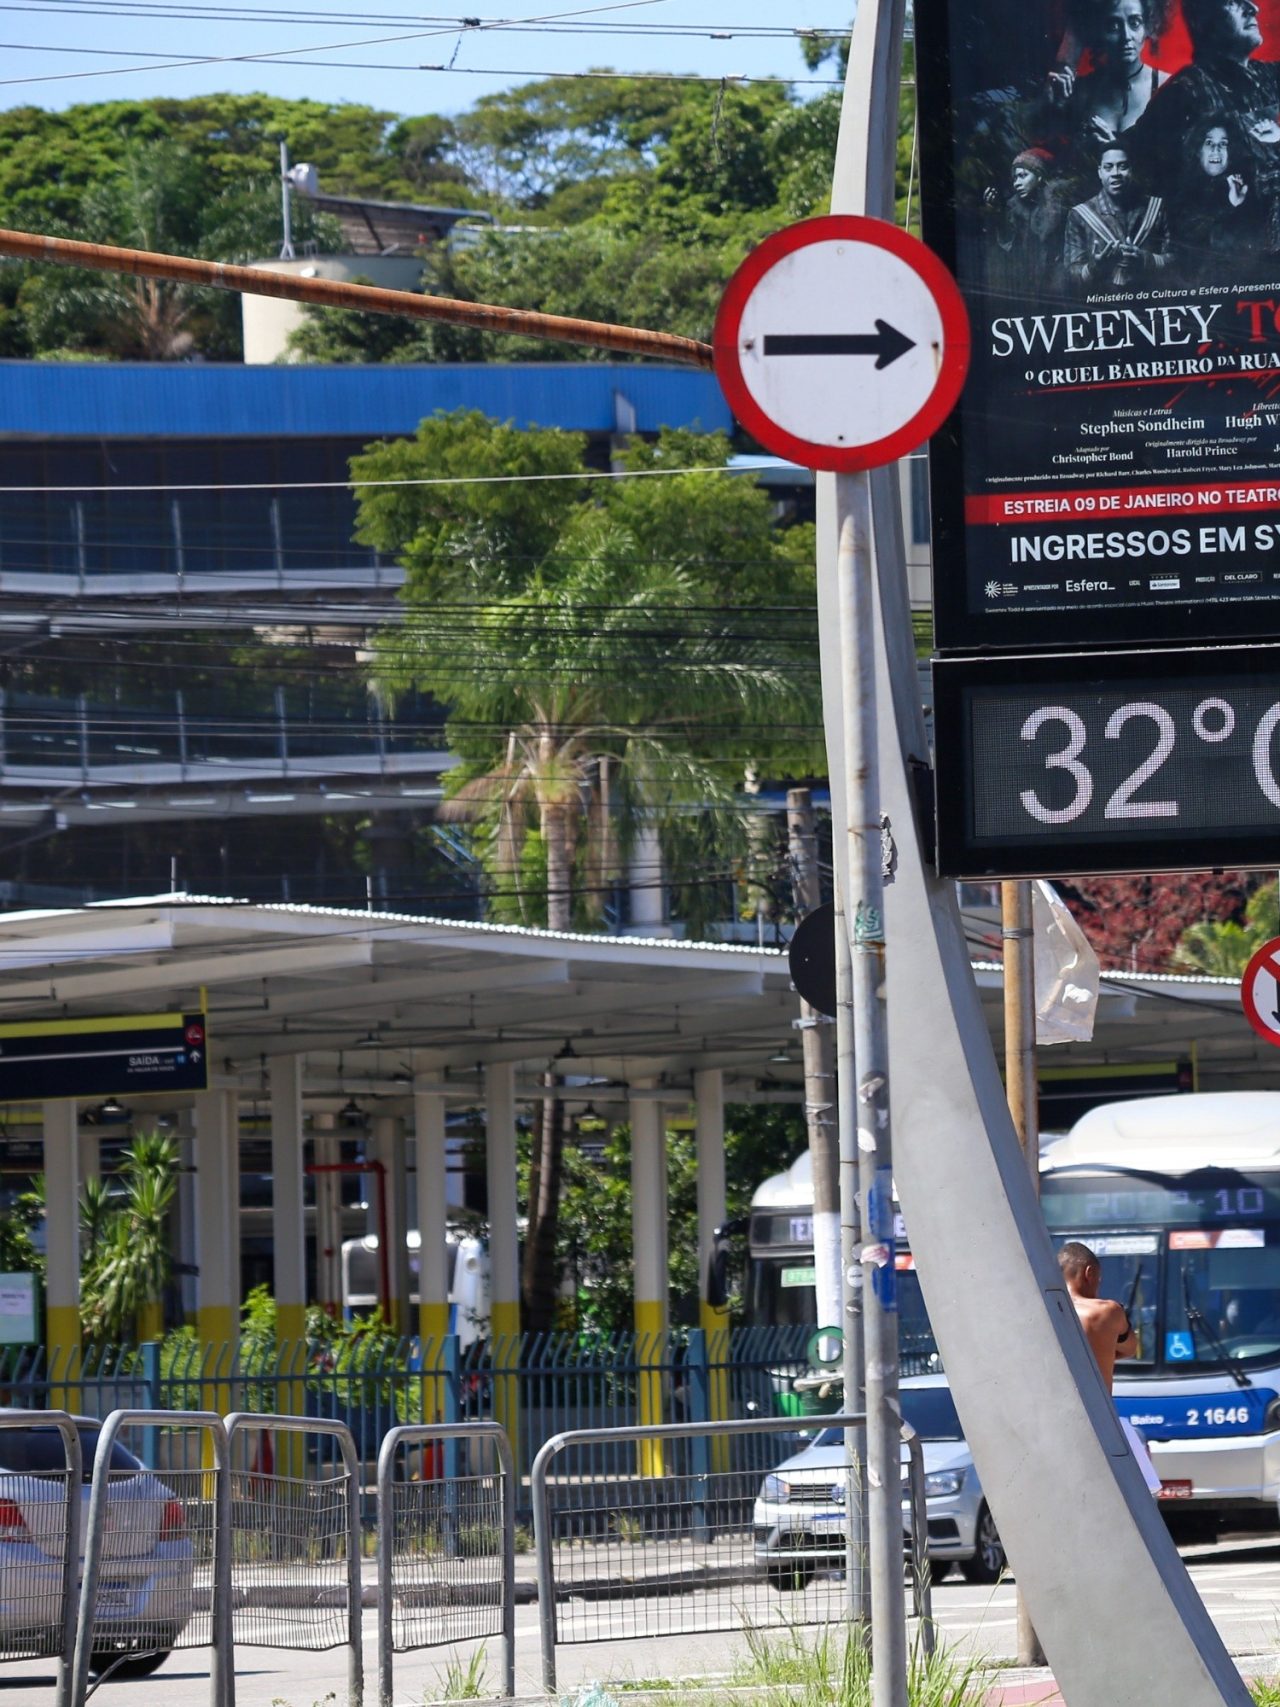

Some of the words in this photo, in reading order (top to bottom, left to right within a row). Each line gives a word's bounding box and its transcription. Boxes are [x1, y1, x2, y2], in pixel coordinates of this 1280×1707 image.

[1086, 291, 1134, 304] Ministério
[1136, 290, 1149, 300] da
[1151, 288, 1187, 299] Cultura
[1190, 289, 1197, 297] e
[1199, 286, 1229, 296] Esfera
[991, 304, 1222, 357] SWEENEY
[1024, 370, 1035, 381] O
[1037, 365, 1105, 386] CRUEL
[1108, 357, 1213, 381] BARBEIRO
[1217, 355, 1236, 366] DA
[1148, 407, 1173, 416] Letras
[1080, 421, 1135, 437] Stephen
[1137, 417, 1205, 432] Sondheim
[1225, 413, 1262, 430] Hugh
[1052, 452, 1108, 464] Christopher
[1109, 450, 1134, 461] Bond
[1166, 446, 1202, 458] Harold
[1205, 445, 1238, 456] Prince
[1004, 498, 1071, 515] ESTREIA
[1074, 496, 1096, 512] 09
[1099, 495, 1121, 510] DE
[1124, 491, 1194, 509] JANEIRO
[1198, 490, 1221, 505] NO
[1011, 528, 1192, 563] INGRESSOS
[1199, 525, 1246, 553] EM
[128, 1055, 160, 1067] SAÍDA
[1186, 1409, 1199, 1426] 2
[1203, 1407, 1249, 1425] 1646
